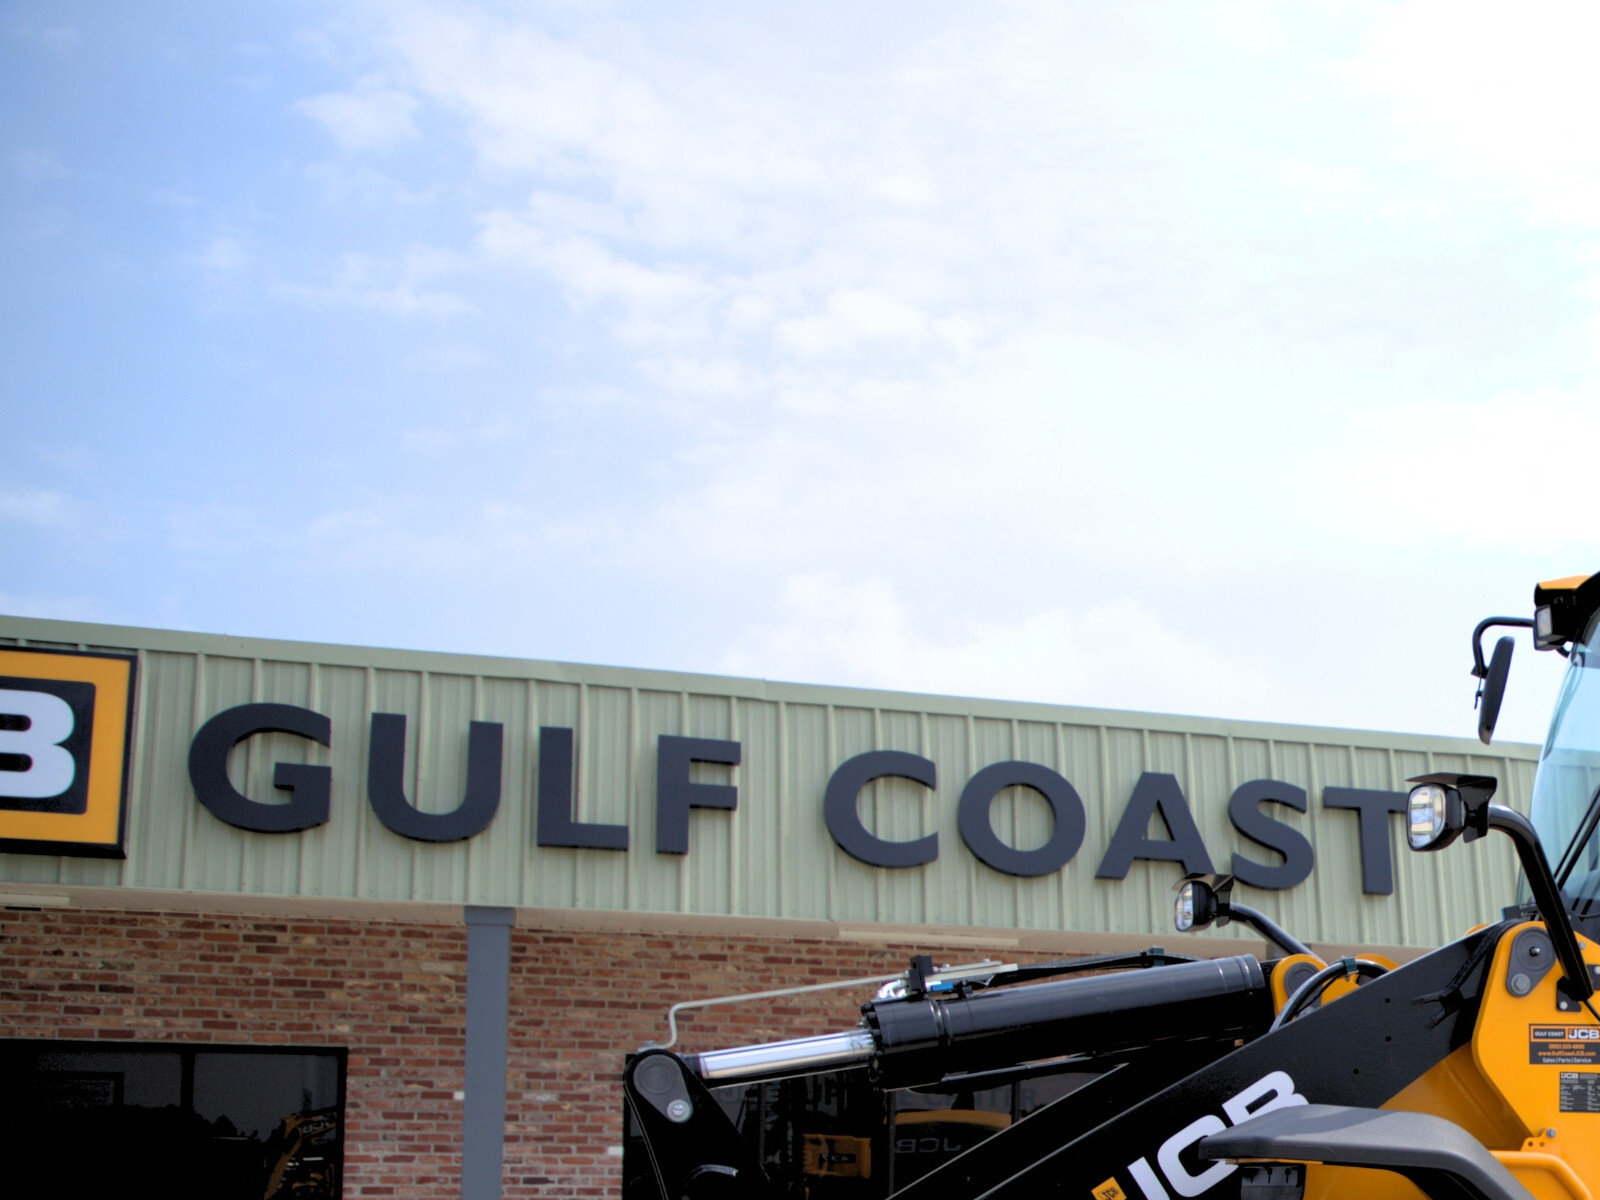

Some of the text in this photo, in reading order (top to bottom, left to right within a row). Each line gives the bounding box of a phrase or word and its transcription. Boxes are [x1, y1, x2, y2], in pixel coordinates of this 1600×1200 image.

[188, 702, 1410, 896] GULF COAST
[1568, 1029, 1600, 1039] JCB
